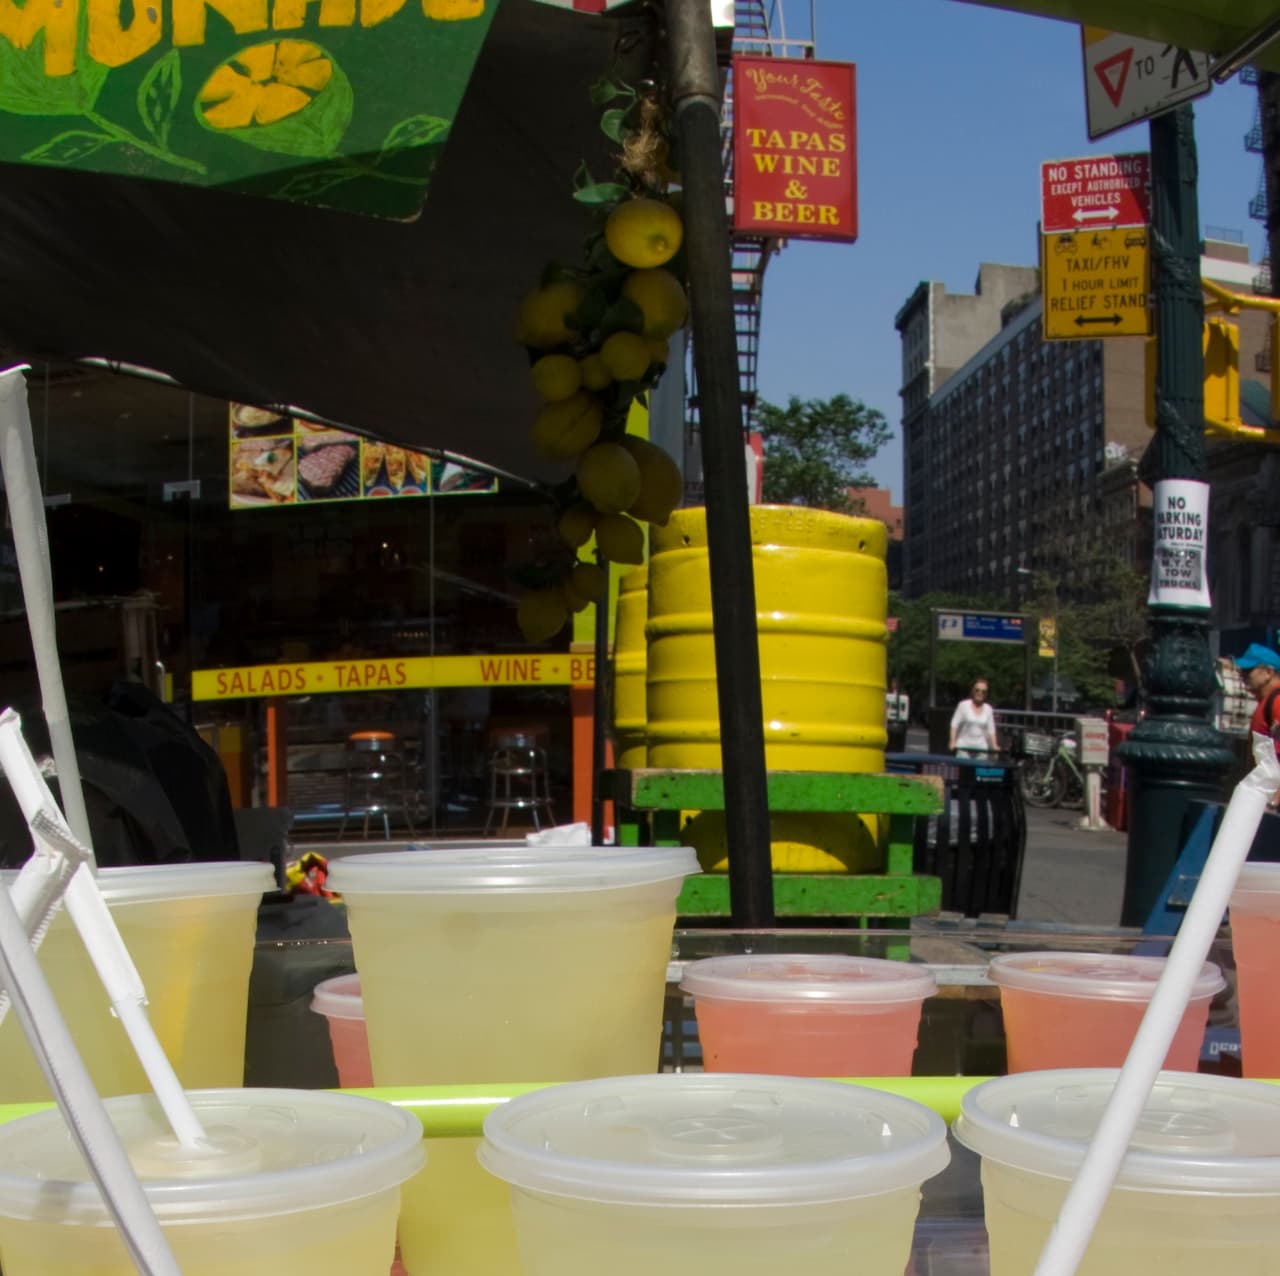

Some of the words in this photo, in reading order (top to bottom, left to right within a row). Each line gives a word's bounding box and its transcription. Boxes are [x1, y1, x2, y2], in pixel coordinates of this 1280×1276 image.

[1136, 56, 1155, 79] TO
[745, 68, 799, 93] Your
[800, 78, 845, 120] Taste
[746, 128, 846, 152] TAPAS
[753, 153, 840, 177] WINE
[1049, 167, 1068, 181] NO
[1074, 161, 1142, 180] STANDING
[784, 179, 808, 199] &
[1051, 182, 1082, 196] EXCEPT
[1087, 177, 1141, 192] AUTHORIZED
[1071, 192, 1122, 207] VEHICLES
[752, 201, 841, 225] BEER
[1066, 255, 1131, 277] TAXI/FHV
[1061, 279, 1067, 296] 1
[1072, 278, 1104, 296] HOUR
[1109, 276, 1138, 294] LIMIT
[1050, 295, 1097, 312] RELIEF
[1104, 293, 1147, 310] STAND
[1168, 496, 1186, 509] NO
[1165, 569, 1192, 578] TOW
[216, 667, 306, 695] SALADS
[334, 661, 407, 687] TAPAS
[480, 659, 542, 681] WINE
